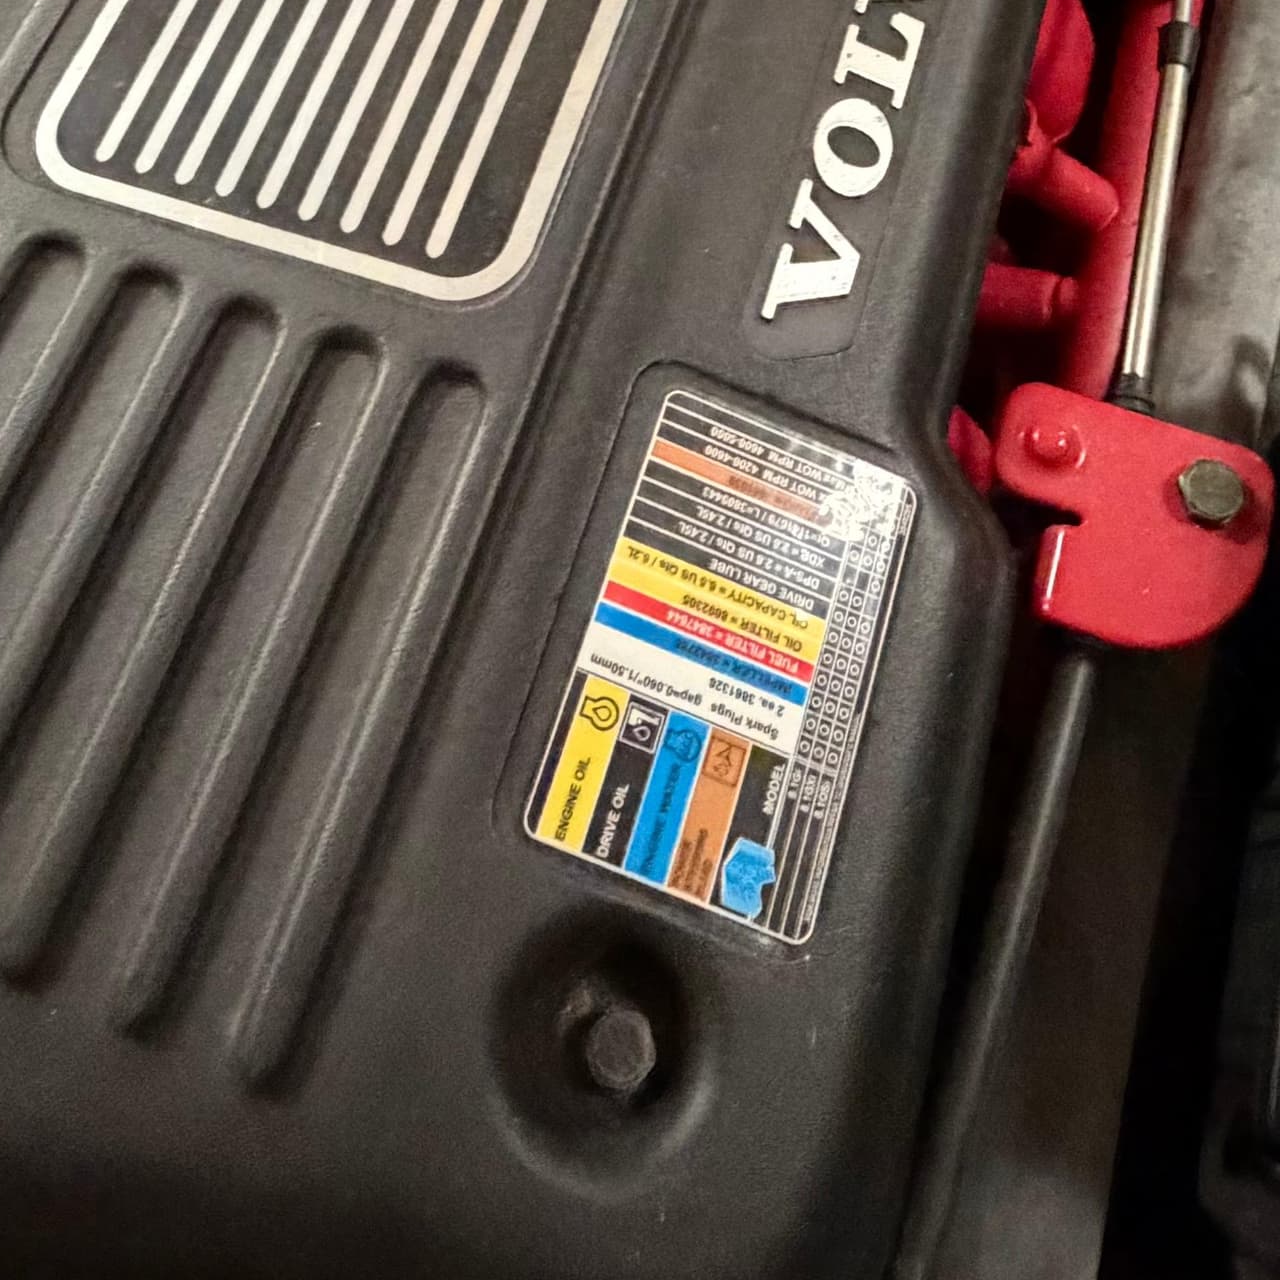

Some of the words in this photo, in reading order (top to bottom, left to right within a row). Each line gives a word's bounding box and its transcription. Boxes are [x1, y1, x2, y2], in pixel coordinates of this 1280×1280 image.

[766, 447, 796, 469] RPM
[794, 459, 824, 481] WOT
[760, 467, 790, 488] RPM
[789, 479, 818, 500] WOT
[707, 556, 743, 579] LUBE
[740, 570, 778, 594] GEAR
[726, 587, 787, 621] CAPACITY
[776, 584, 816, 609] DRIVE
[737, 617, 783, 644] FILTER
[723, 632, 767, 659] FILTER
[780, 635, 803, 652] OIL
[765, 649, 800, 672] FUEL
[707, 699, 745, 726] Plugs
[773, 704, 785, 716] 2
[742, 715, 780, 741] Spark
[554, 782, 580, 841] ENGINE
[573, 754, 591, 781] OIL
[762, 760, 785, 815] MODEL
[596, 809, 621, 859] DRIVE
[612, 780, 629, 810] OIL
